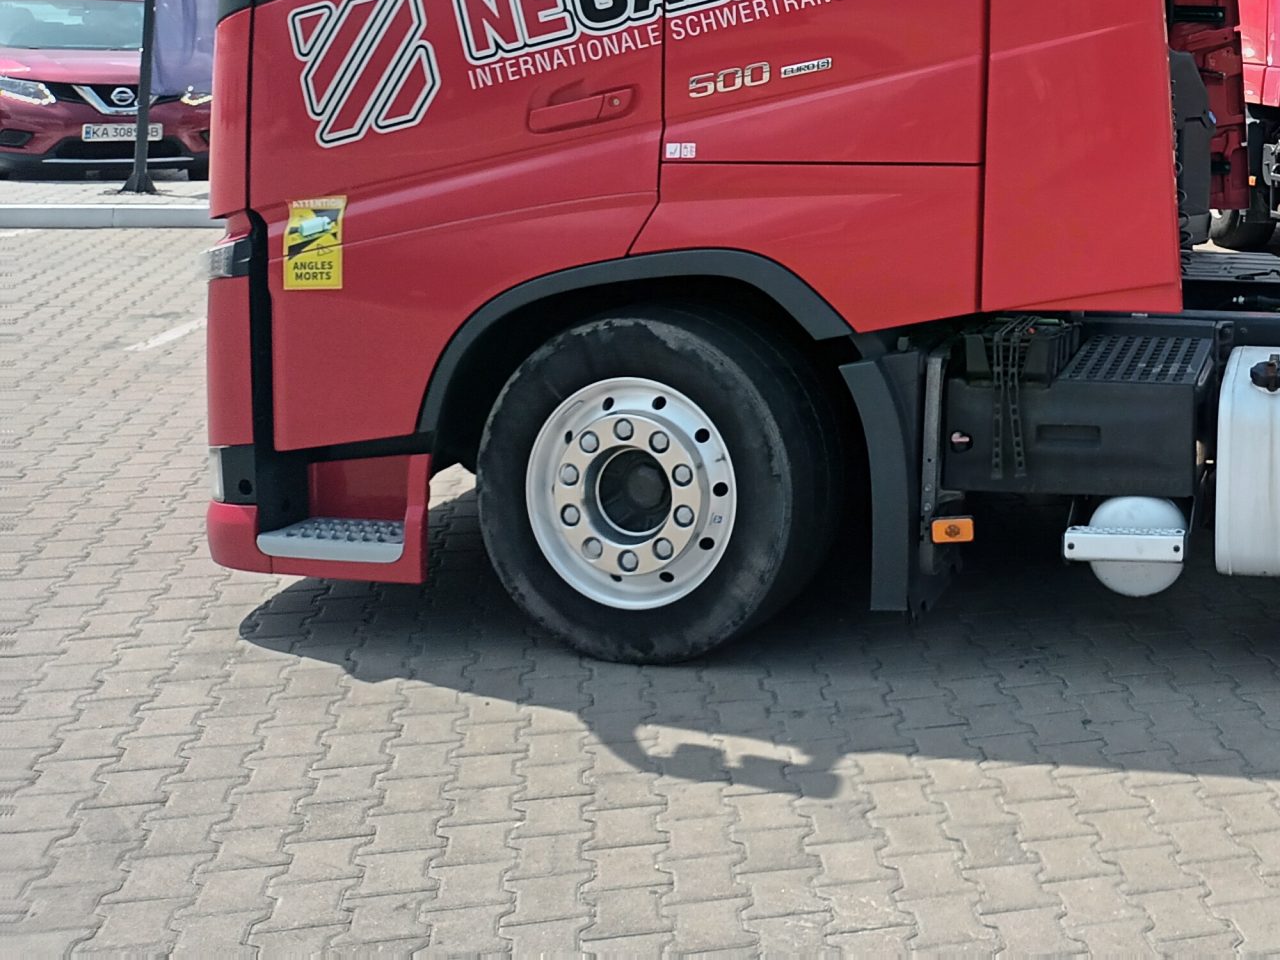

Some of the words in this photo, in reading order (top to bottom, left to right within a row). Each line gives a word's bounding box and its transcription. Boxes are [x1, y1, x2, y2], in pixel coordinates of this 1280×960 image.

[467, 25, 662, 90] INTERNATIONALE
[688, 61, 771, 99] 500
[92, 127, 109, 138] KA
[293, 260, 333, 271] ANGLES
[295, 271, 332, 281] MORTS
